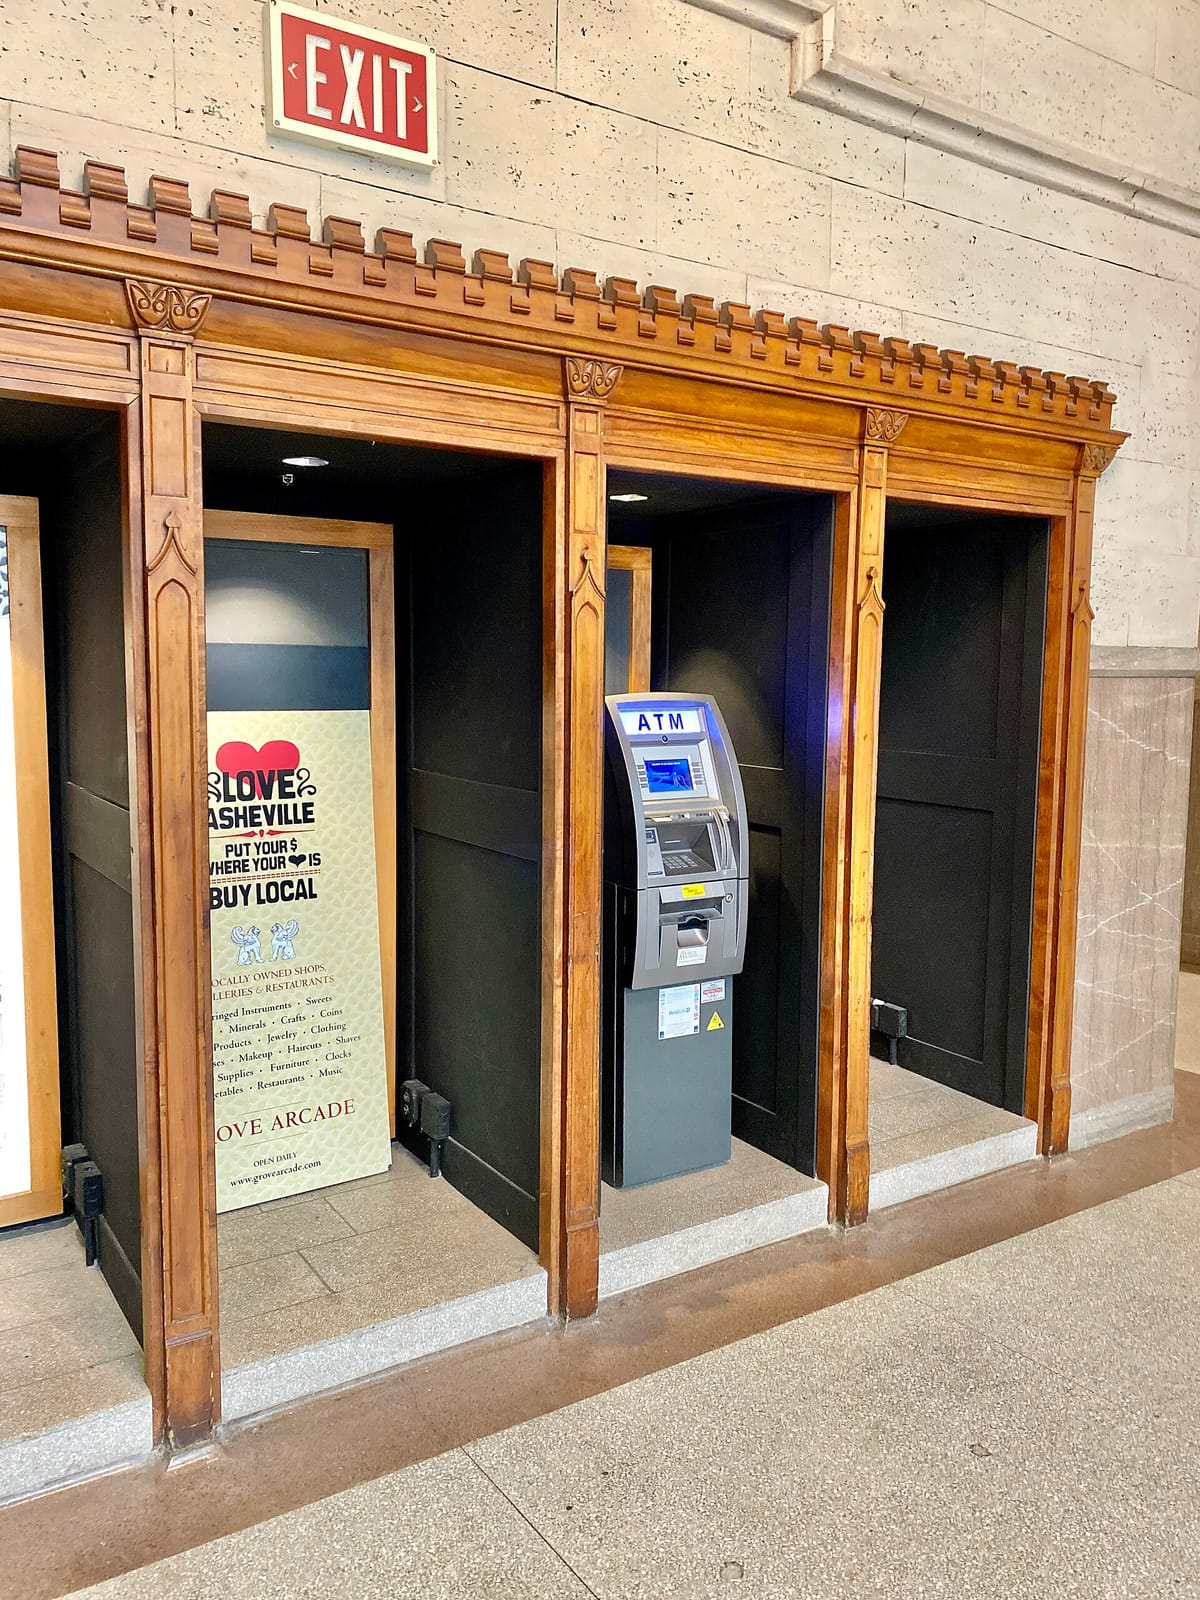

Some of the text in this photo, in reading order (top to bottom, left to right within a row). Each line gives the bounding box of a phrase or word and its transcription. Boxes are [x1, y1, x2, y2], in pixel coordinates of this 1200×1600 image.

[305, 33, 413, 140] EXIT
[638, 713, 684, 731] ATM
[222, 769, 296, 802] LOVE
[208, 802, 315, 830] ASHEVILLE
[225, 838, 298, 858] PUT YOUR $
[252, 855, 286, 871] YOUR
[308, 853, 321, 867] IS
[209, 878, 317, 910] BUY LOCAL
[211, 974, 250, 987] OCALLY
[253, 968, 292, 982] OWNED
[212, 987, 253, 1001] LLERIES
[265, 975, 335, 993] RESTAURANTS
[212, 996, 332, 1022] ringed Instruments Sweets
[228, 1008, 343, 1034] Minerals Crafts Coins
[213, 1022, 347, 1051] Products Jewelry Clothing
[239, 1051, 273, 1063] Makeup
[287, 1042, 322, 1054] Haircuts
[335, 1035, 361, 1046] Shaves
[217, 1051, 352, 1083] Supplies Furniture Clocks
[213, 1066, 343, 1099] etables Restaurants Music
[215, 1099, 356, 1142] OVE ARCADE
[230, 1160, 322, 1187] www.grovearcade.com
[253, 1152, 298, 1168] OPEN DAILY
